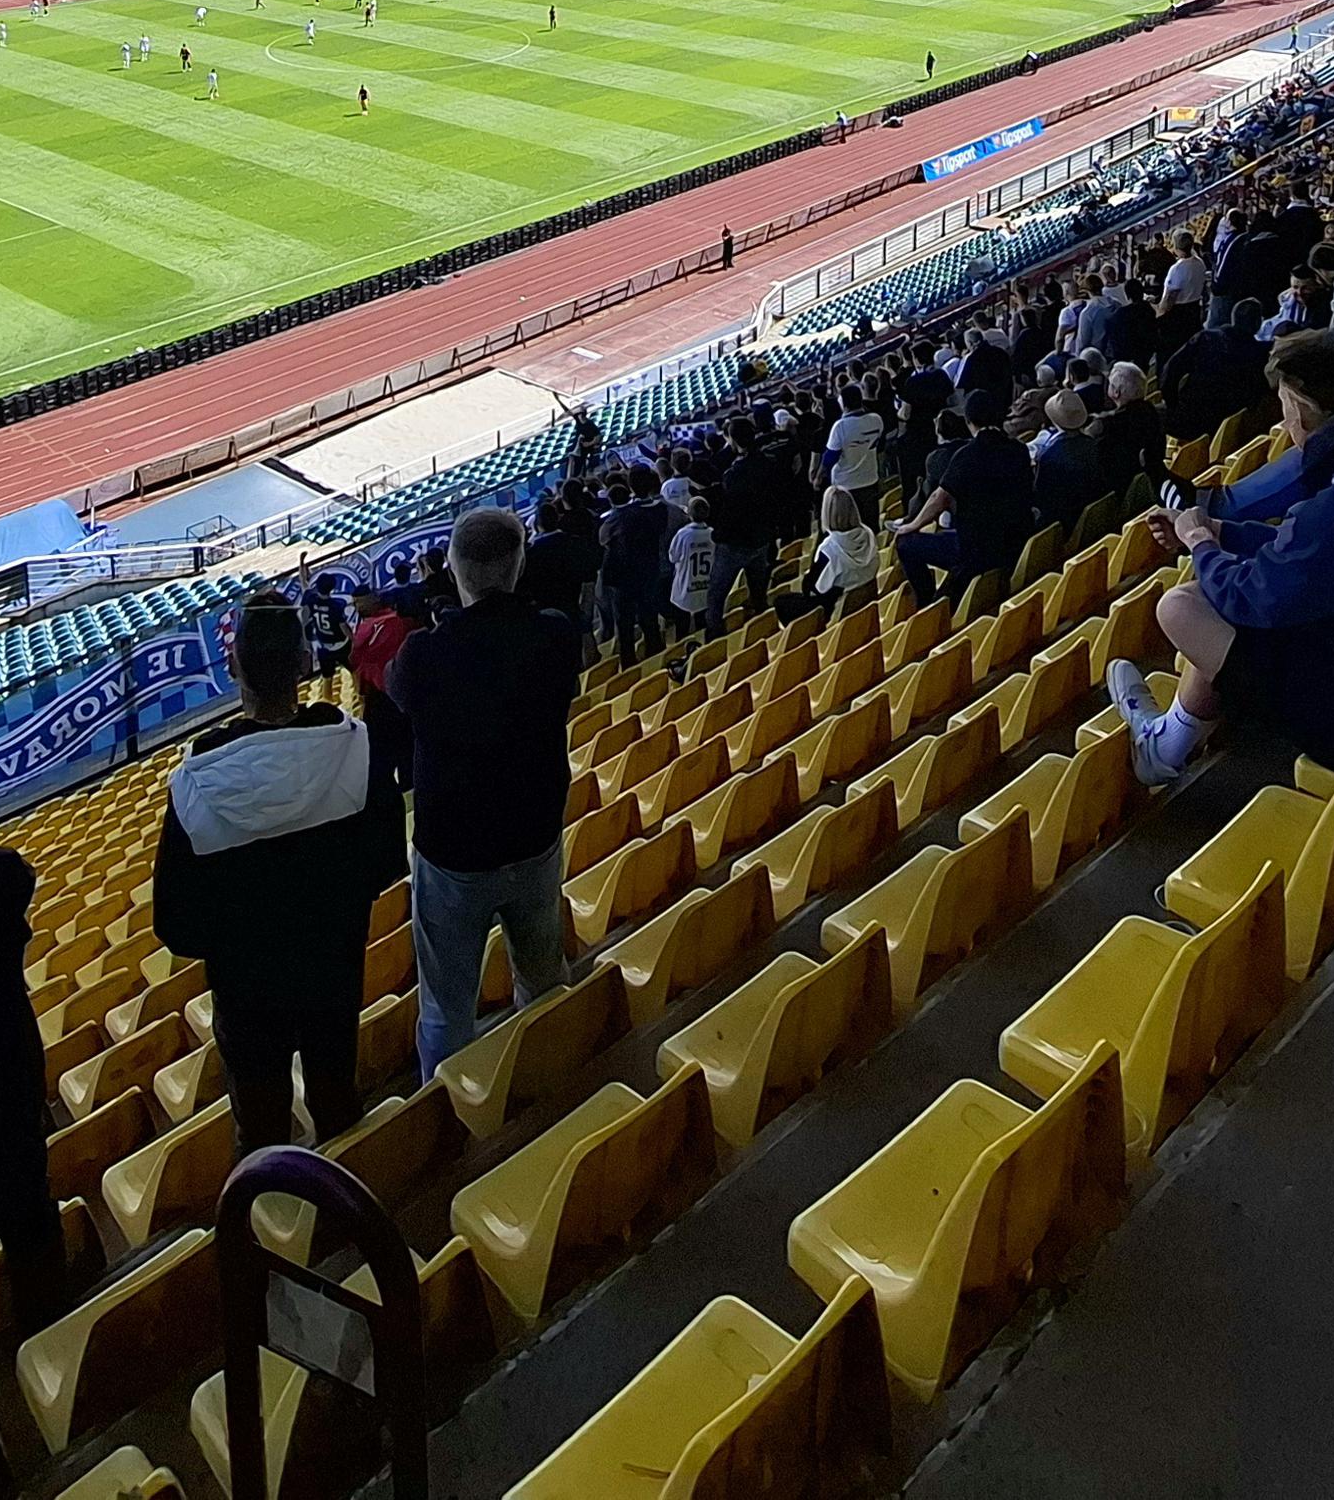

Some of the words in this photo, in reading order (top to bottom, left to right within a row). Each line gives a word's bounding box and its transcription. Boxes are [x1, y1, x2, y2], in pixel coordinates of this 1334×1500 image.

[999, 122, 1034, 148] Tipsport
[940, 144, 977, 173] Tipsport
[689, 550, 712, 577] 15
[312, 612, 331, 631] 15
